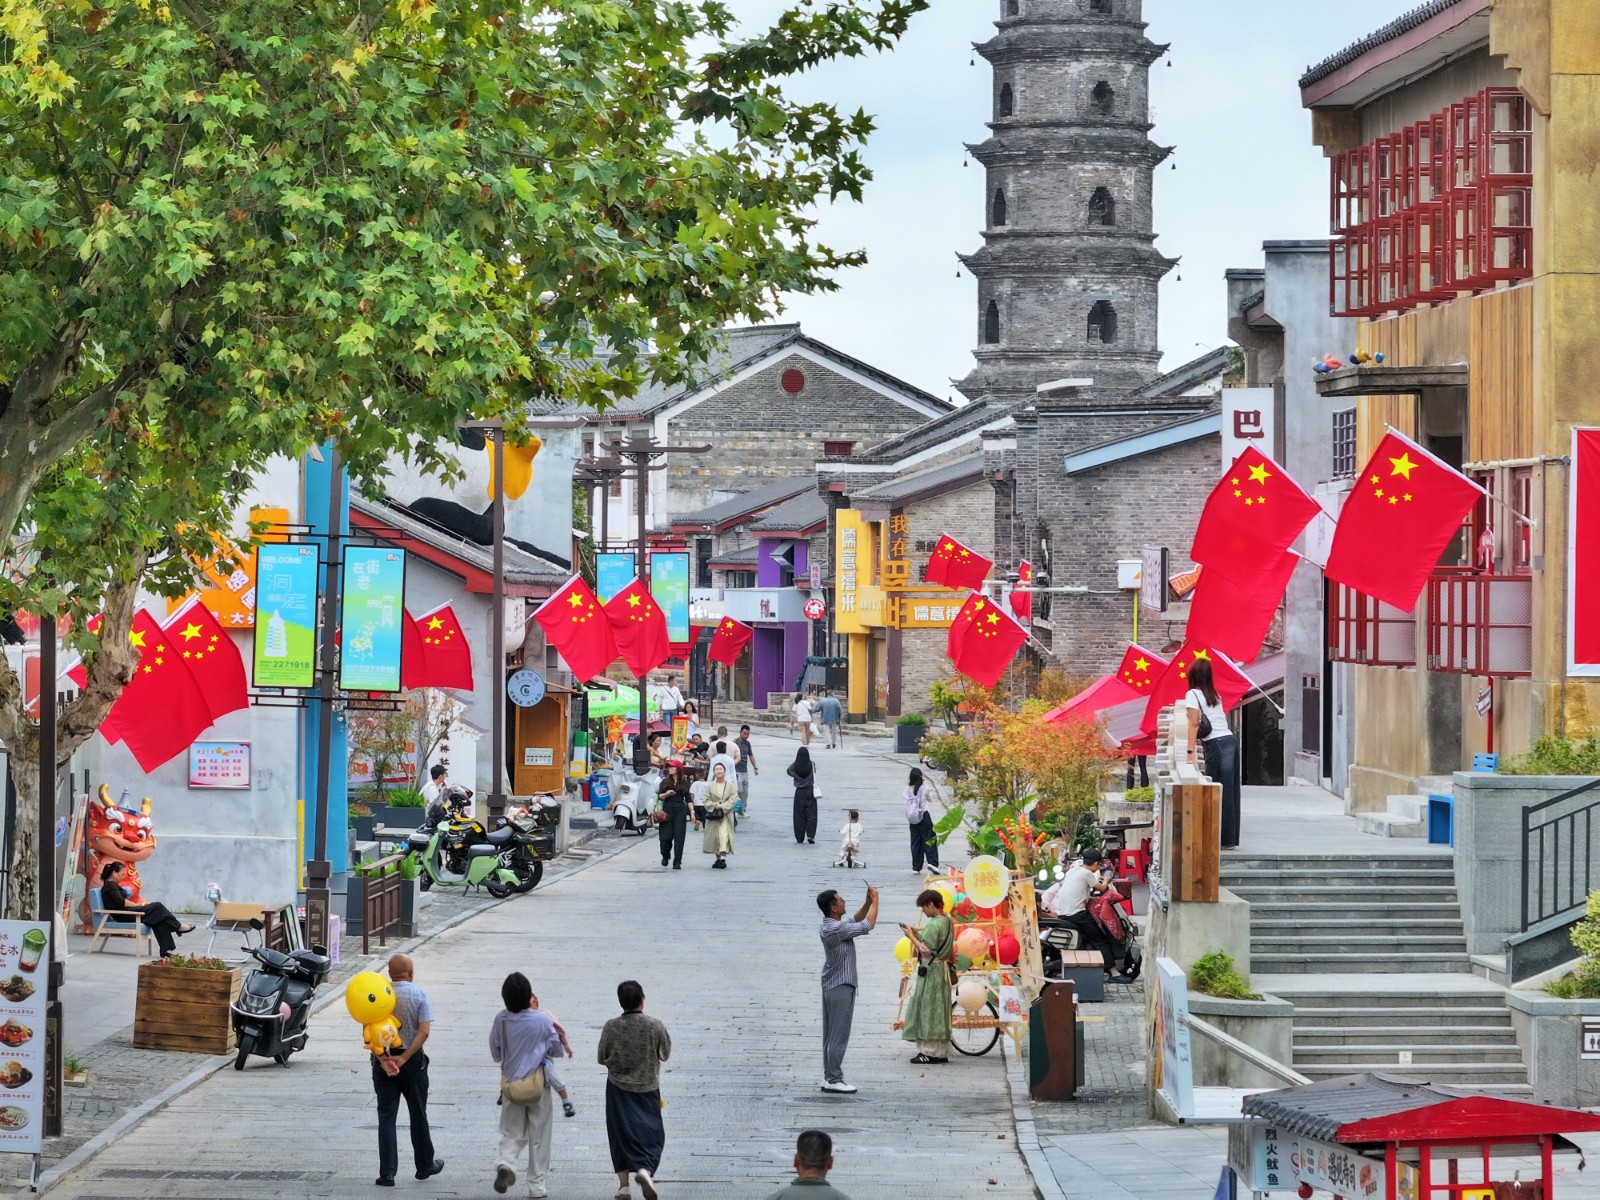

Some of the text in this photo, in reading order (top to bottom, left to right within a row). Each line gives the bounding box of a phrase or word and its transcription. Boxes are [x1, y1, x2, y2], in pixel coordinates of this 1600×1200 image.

[890, 514, 911, 558] 我在
[261, 555, 303, 564] WELCOME
[272, 660, 310, 669] 2271918
[358, 664, 396, 673] 2271918
[1265, 1128, 1279, 1186] 烈火鱿鱼
